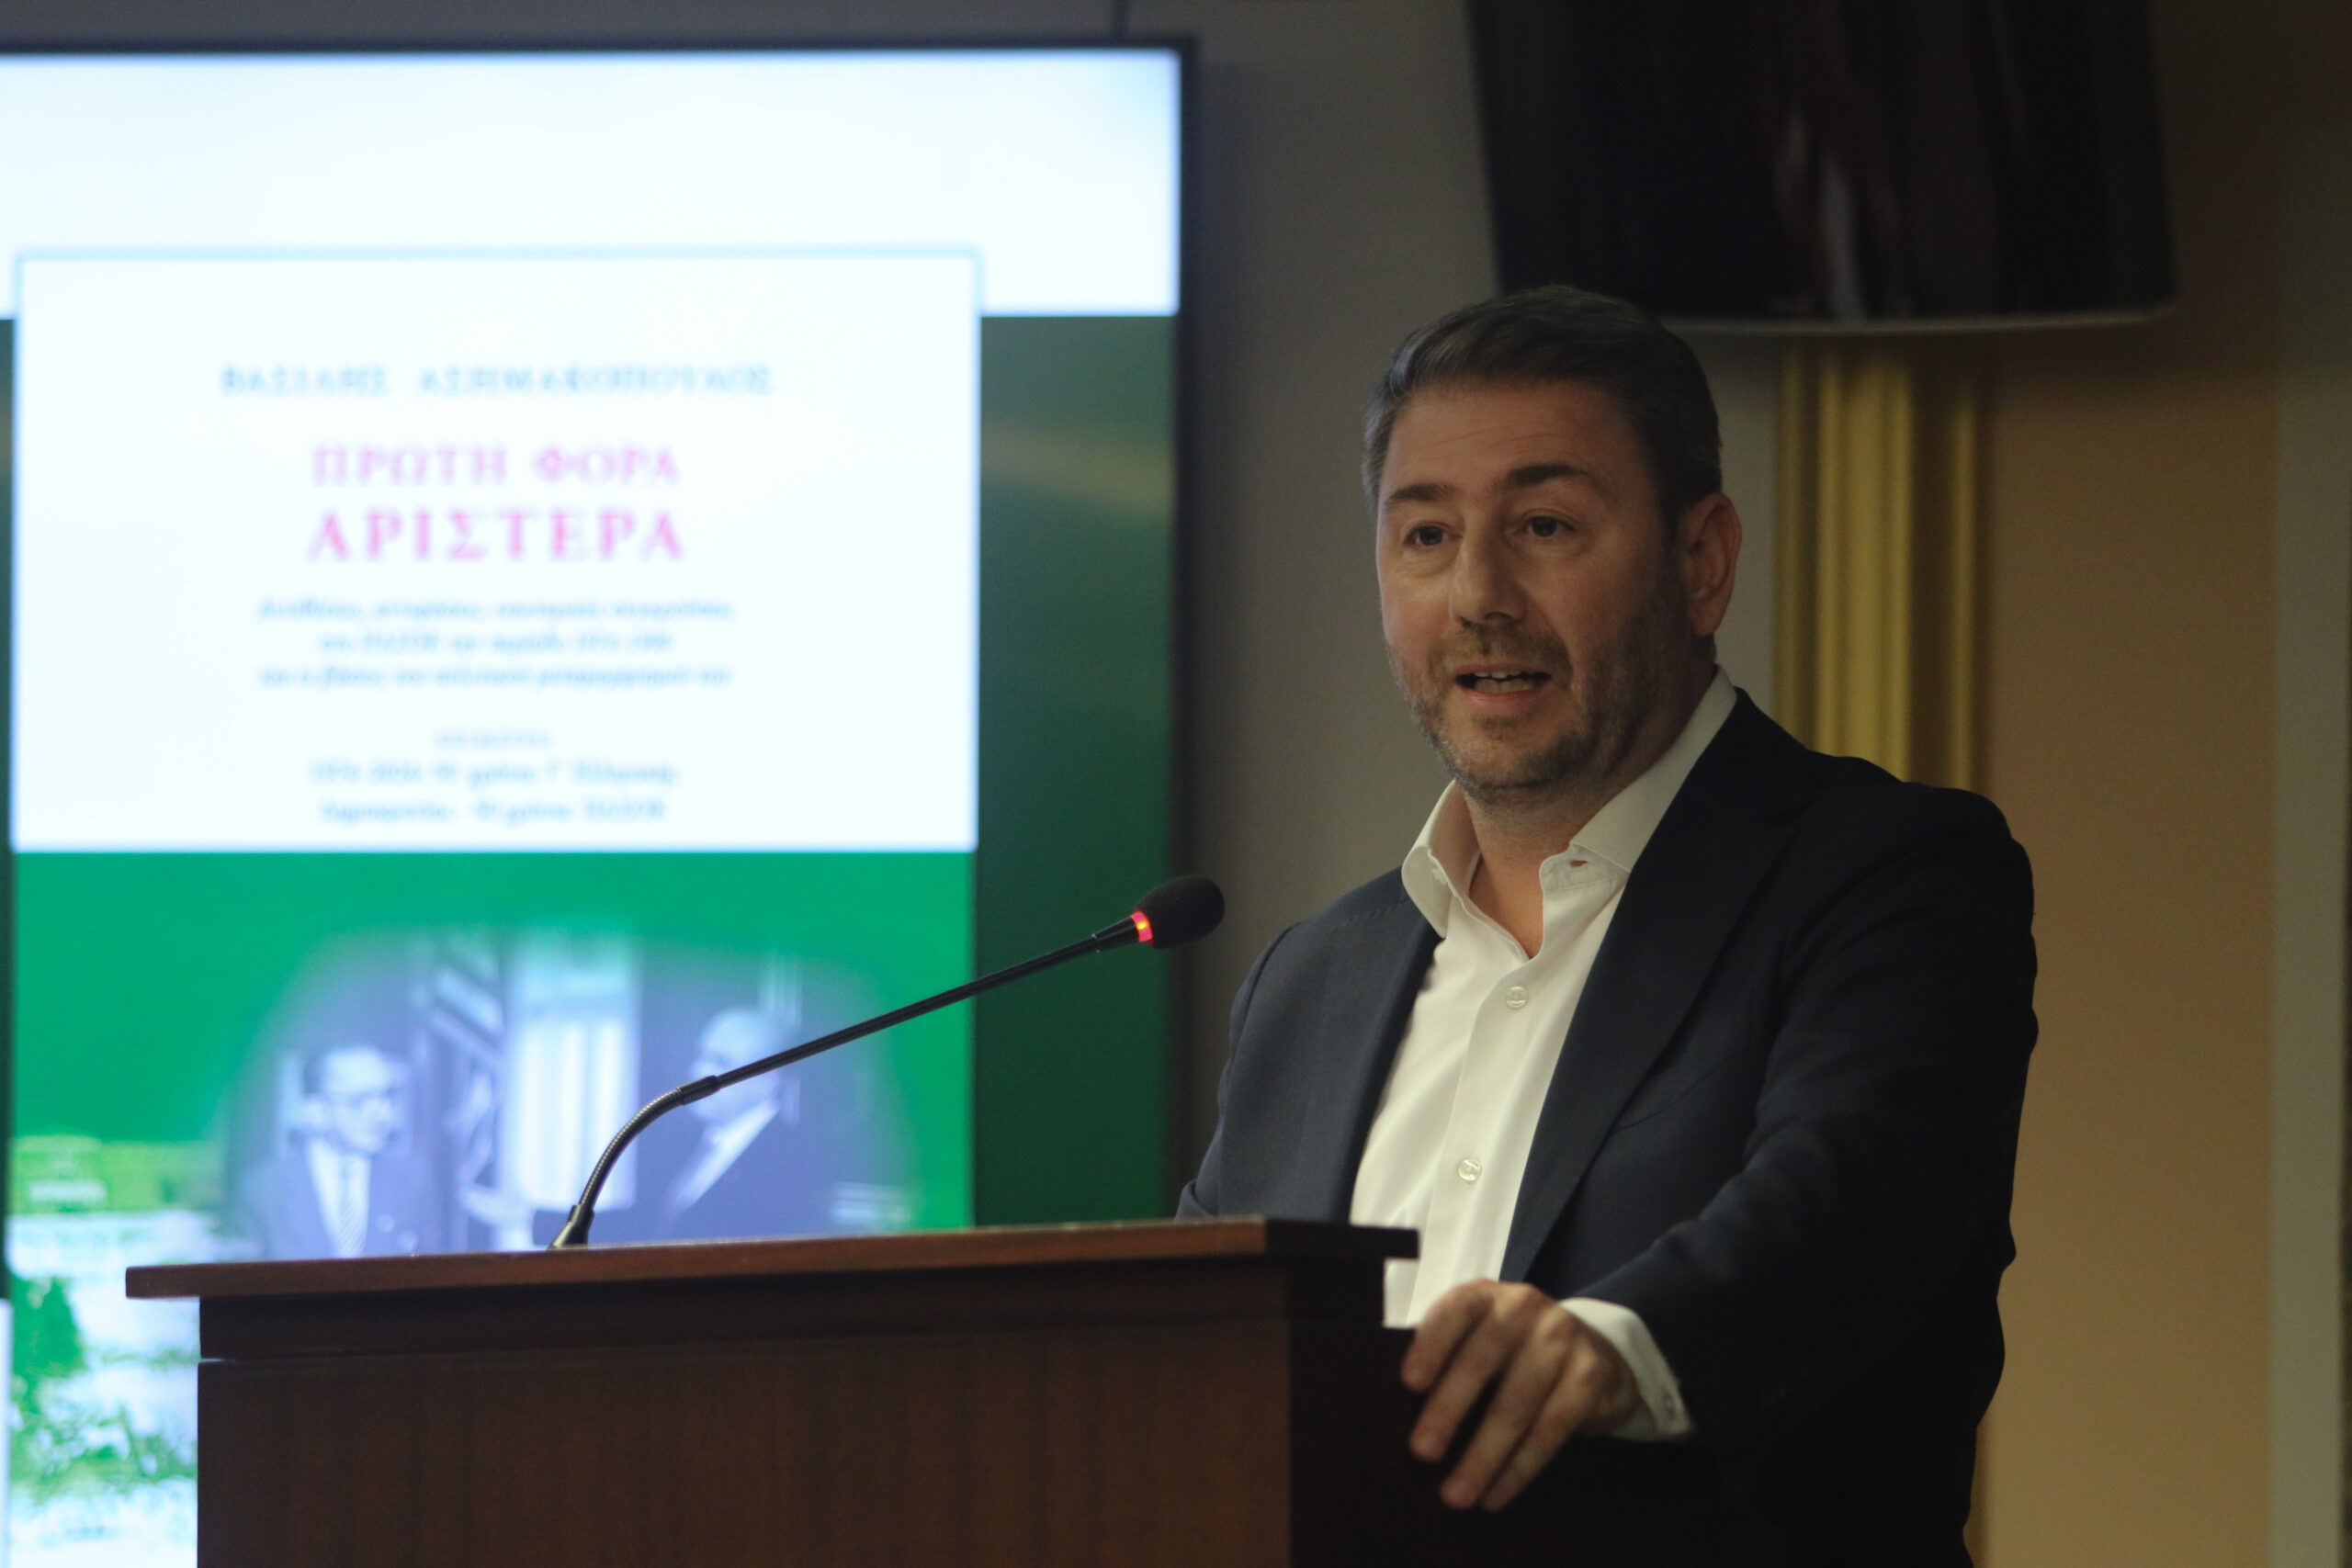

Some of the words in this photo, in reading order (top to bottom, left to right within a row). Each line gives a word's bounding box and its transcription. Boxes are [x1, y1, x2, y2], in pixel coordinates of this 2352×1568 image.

[311, 444, 508, 486] ΠΡΩΤΗ
[532, 444, 681, 485] ΦΟΡΑ
[307, 506, 685, 562] ΑΡΙΣΤΕΡΑ
